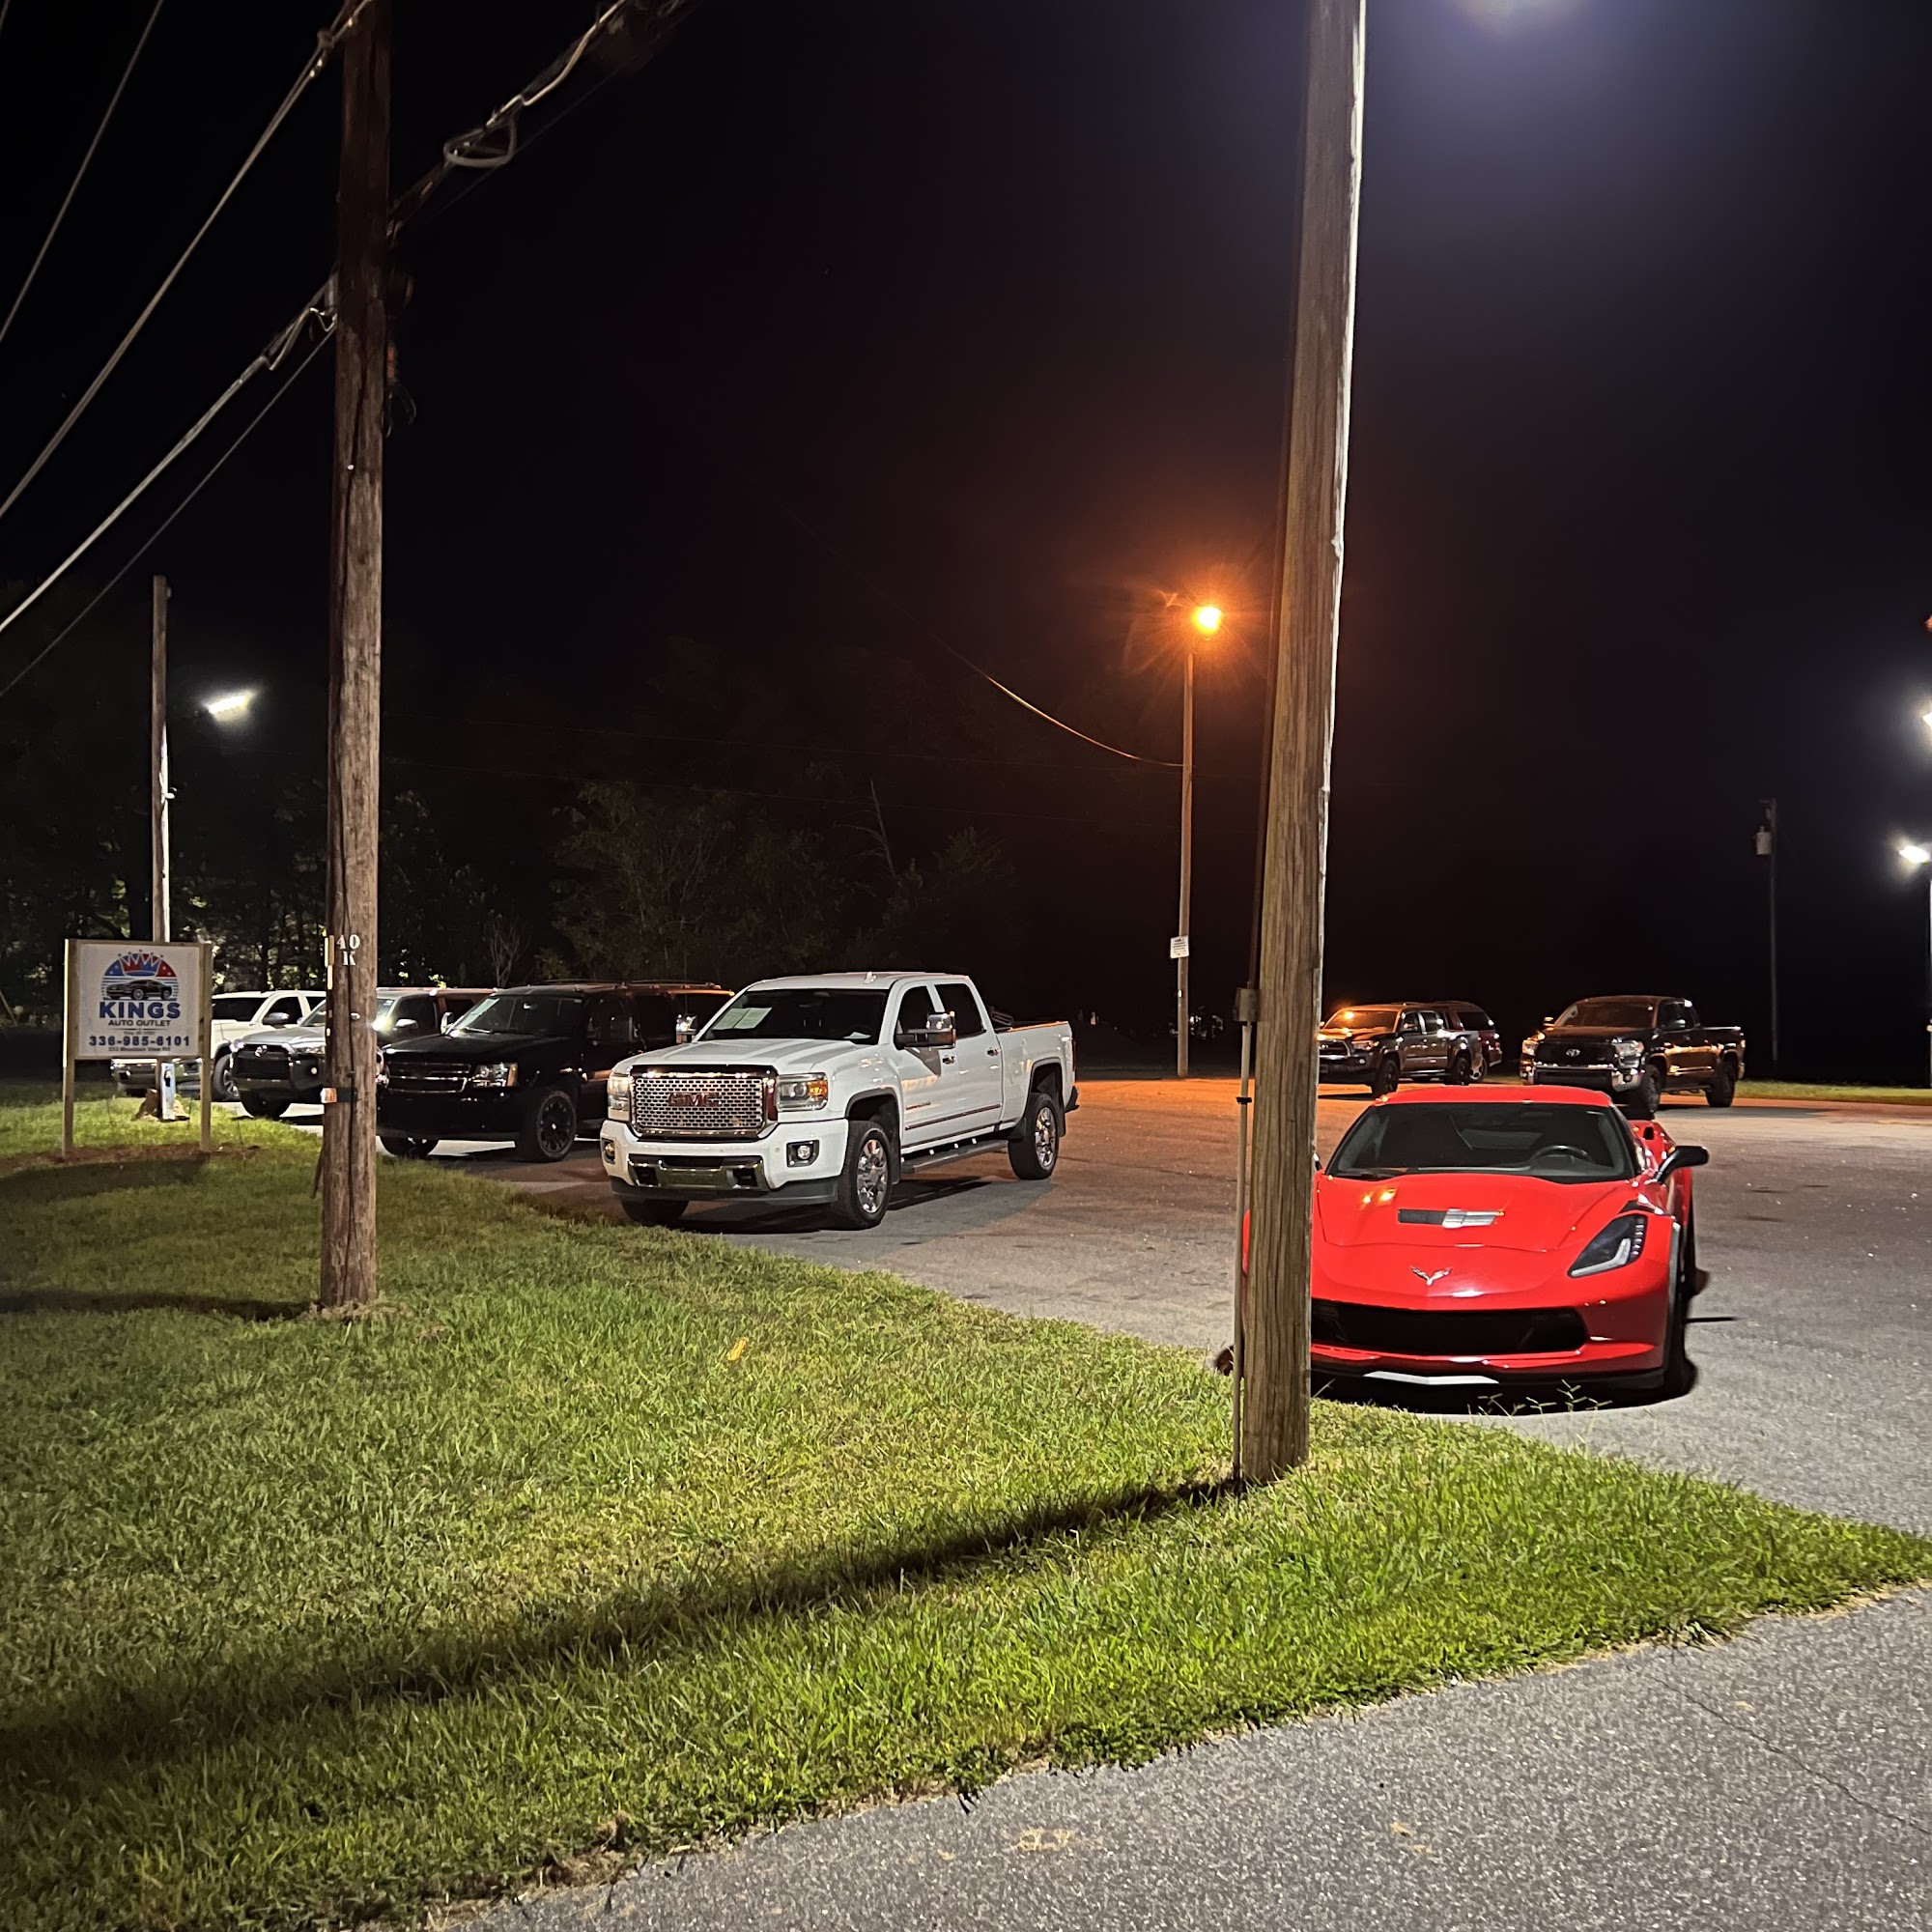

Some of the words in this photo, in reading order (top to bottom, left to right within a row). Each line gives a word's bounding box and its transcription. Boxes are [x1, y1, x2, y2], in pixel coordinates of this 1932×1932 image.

[336, 934, 360, 950] 40
[99, 1001, 181, 1019] KINGS
[89, 1036, 190, 1046] 336-985-6101
[668, 1093, 723, 1107] GMC
